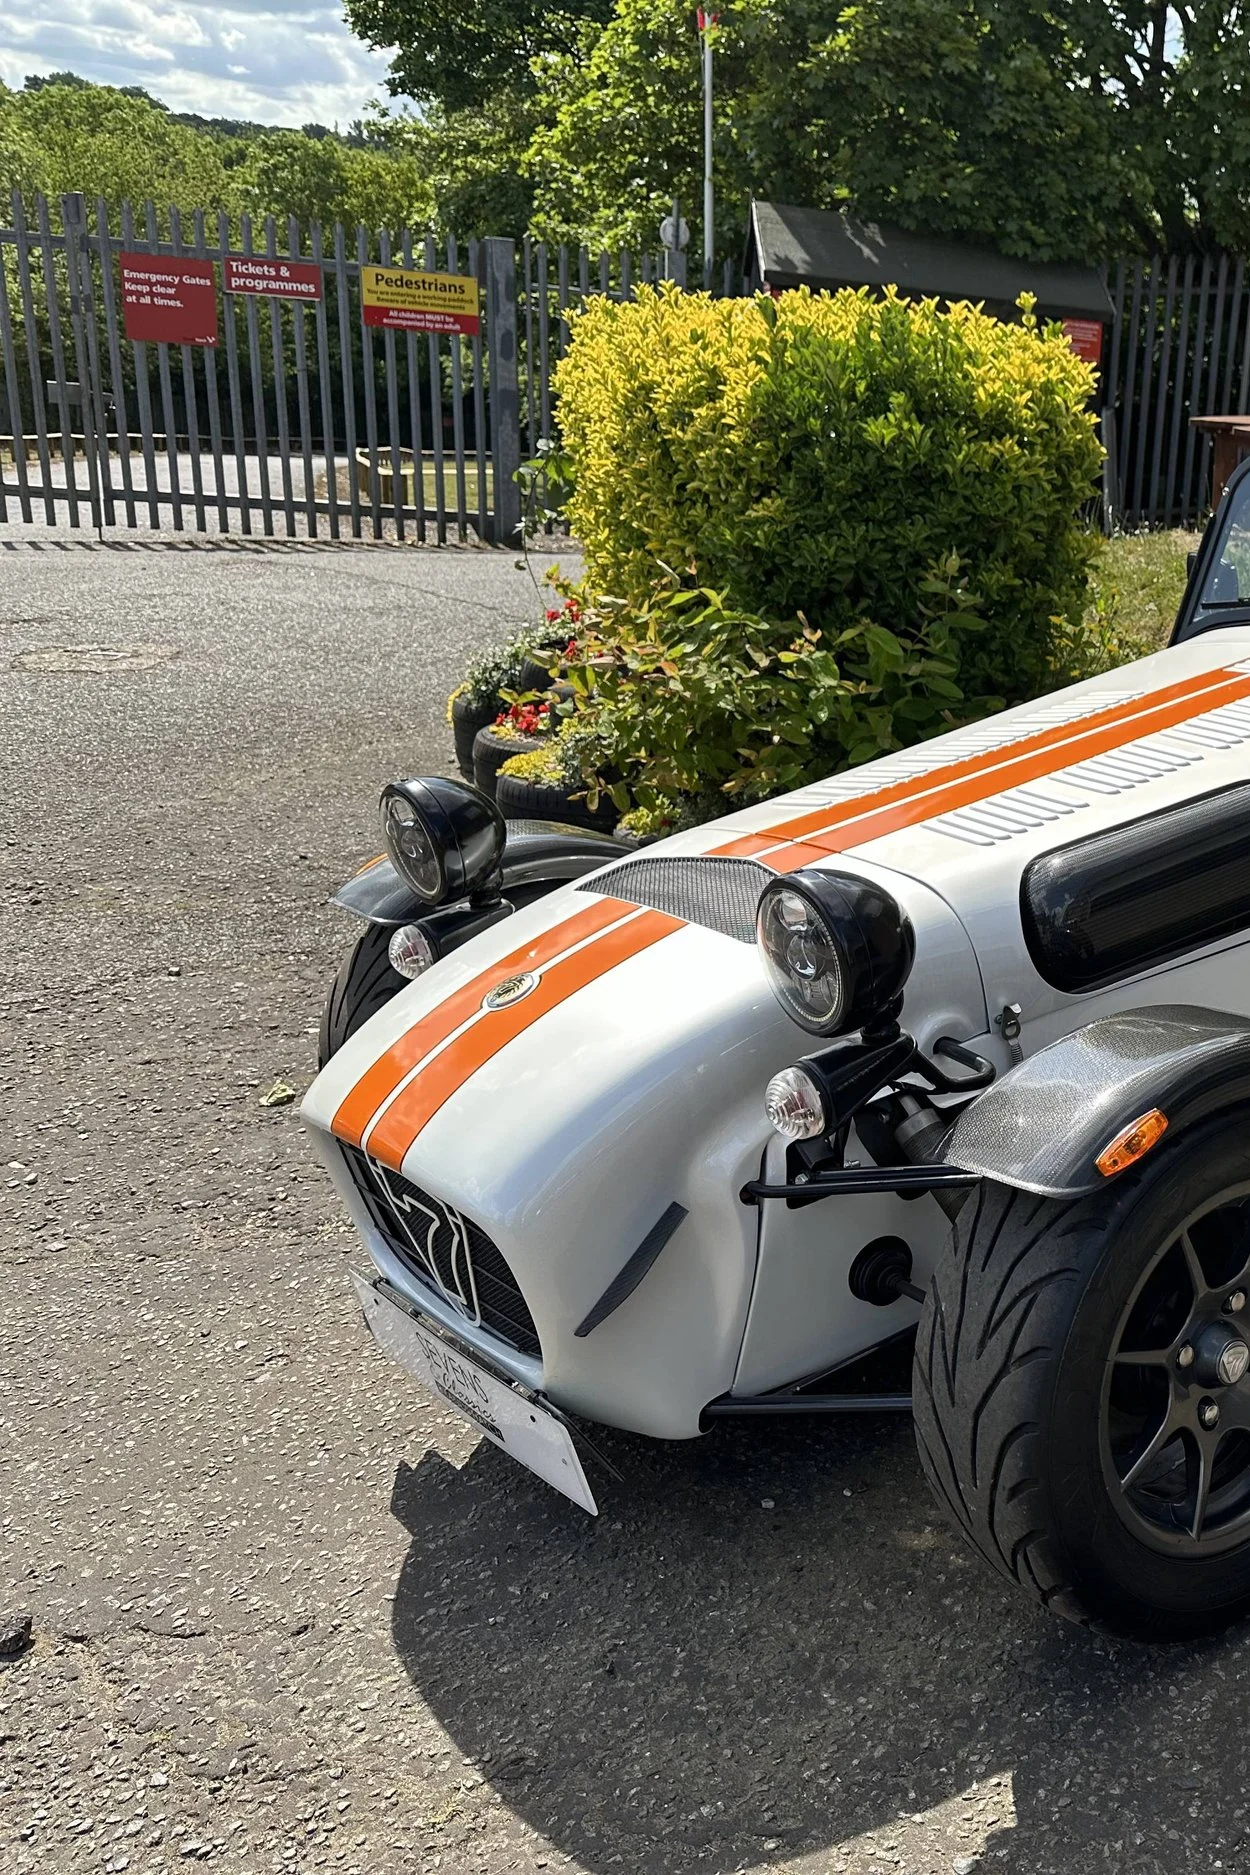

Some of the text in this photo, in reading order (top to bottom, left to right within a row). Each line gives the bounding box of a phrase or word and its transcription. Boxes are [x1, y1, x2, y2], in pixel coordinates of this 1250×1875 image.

[123, 269, 212, 286] Emergency Gates
[229, 261, 290, 278] Tickets &
[124, 281, 177, 295] Keep clear
[230, 277, 316, 293] programmes
[375, 273, 465, 295] Pedestrians
[126, 295, 184, 308] at all times.
[389, 309, 454, 323] All children MUST be
[415, 1332, 489, 1404] SEVENS
